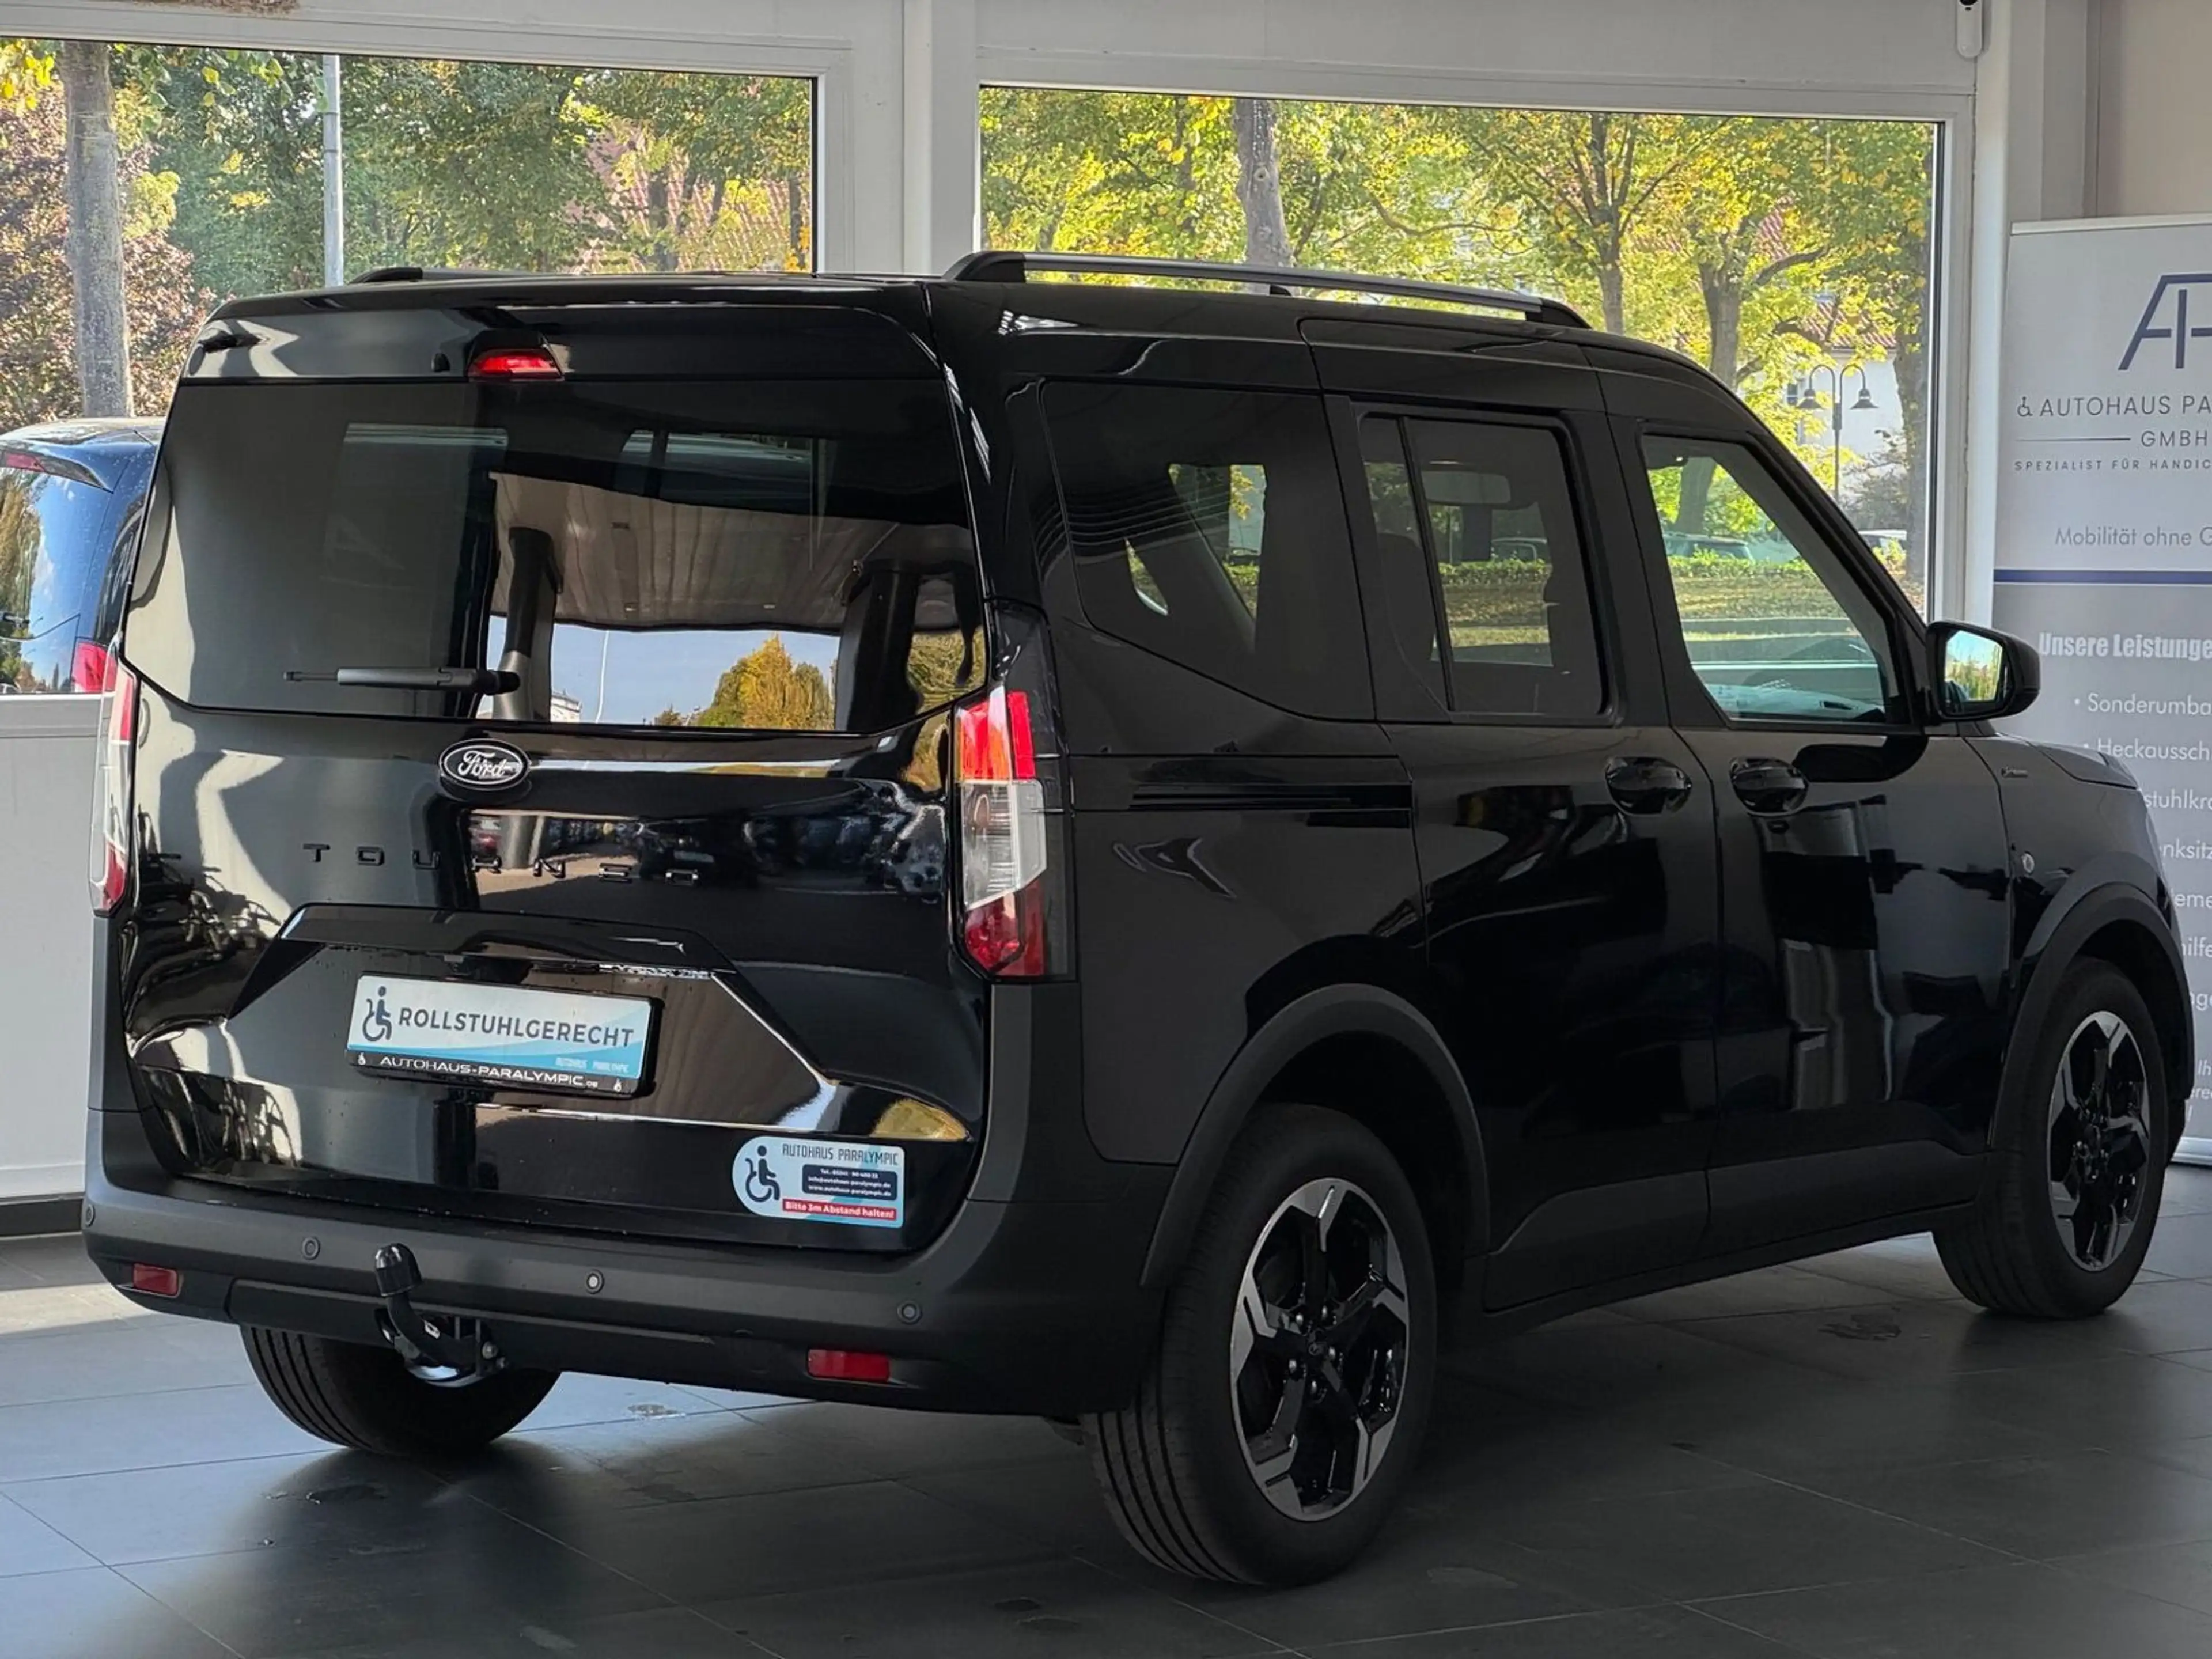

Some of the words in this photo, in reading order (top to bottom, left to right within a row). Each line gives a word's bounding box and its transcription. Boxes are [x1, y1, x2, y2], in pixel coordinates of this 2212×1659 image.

[2040, 395, 2170, 417] AUTOHAUS
[2182, 395, 2211, 414] PA
[2141, 430, 2207, 447] GMBH
[2015, 460, 2102, 471] SPEZIALIST
[2112, 457, 2139, 470] FÜR
[2055, 525, 2137, 546] Mobilität
[2143, 526, 2191, 546] ohne
[2039, 632, 2109, 657] Unsere
[2088, 692, 2212, 715] Sonderumba
[457, 750, 507, 777] Ford
[399, 1007, 634, 1048] ROLLSTUHLGERECHT
[782, 1143, 834, 1160] AUTOHAUS
[838, 1148, 899, 1165] PARALYMPIC
[785, 1201, 807, 1210] Bitte
[823, 1205, 861, 1215] Abstand
[862, 1208, 895, 1219] halten!
